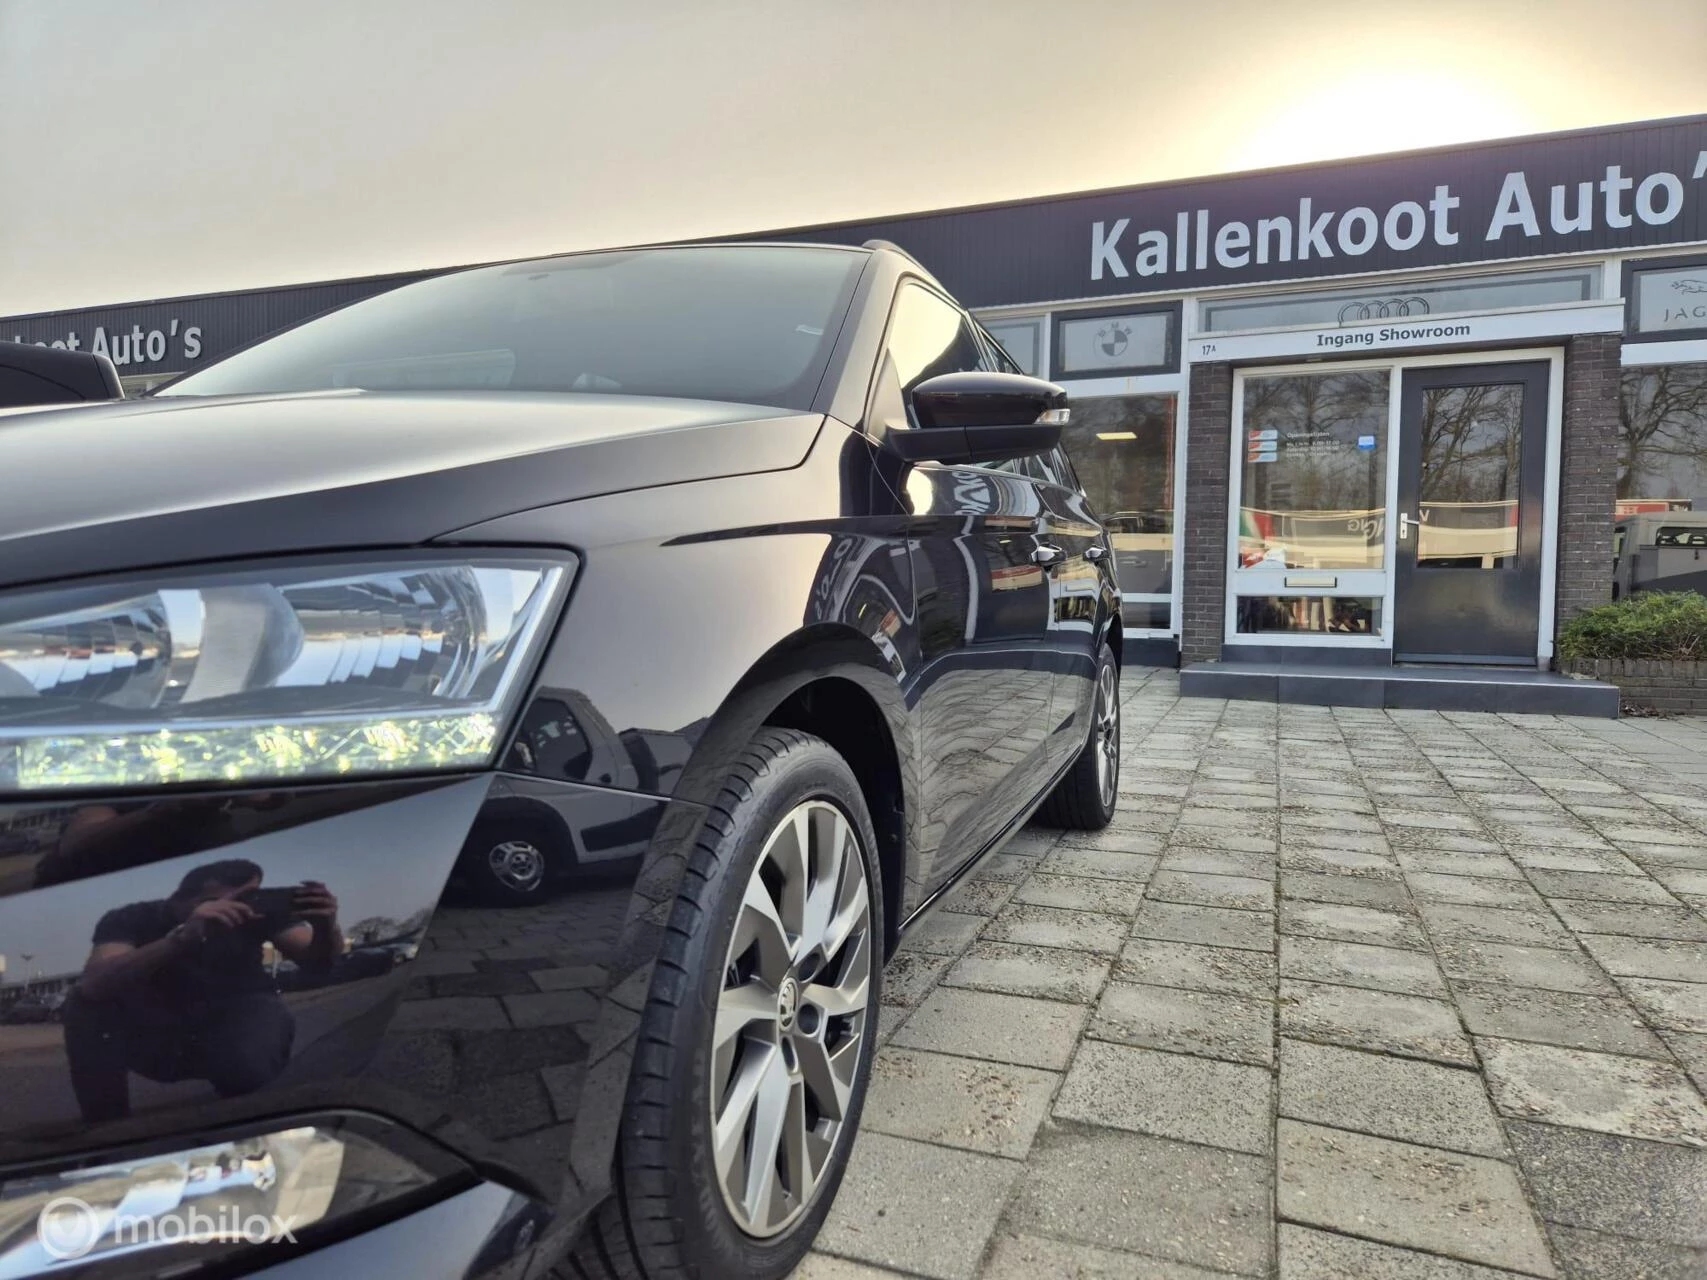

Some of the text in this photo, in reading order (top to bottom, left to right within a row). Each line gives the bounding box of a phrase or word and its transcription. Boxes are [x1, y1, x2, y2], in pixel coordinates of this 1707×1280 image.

[1090, 184, 1460, 281] Kallenkoot
[91, 318, 202, 366] Auto's
[1316, 325, 1471, 347] Ingang Showroom
